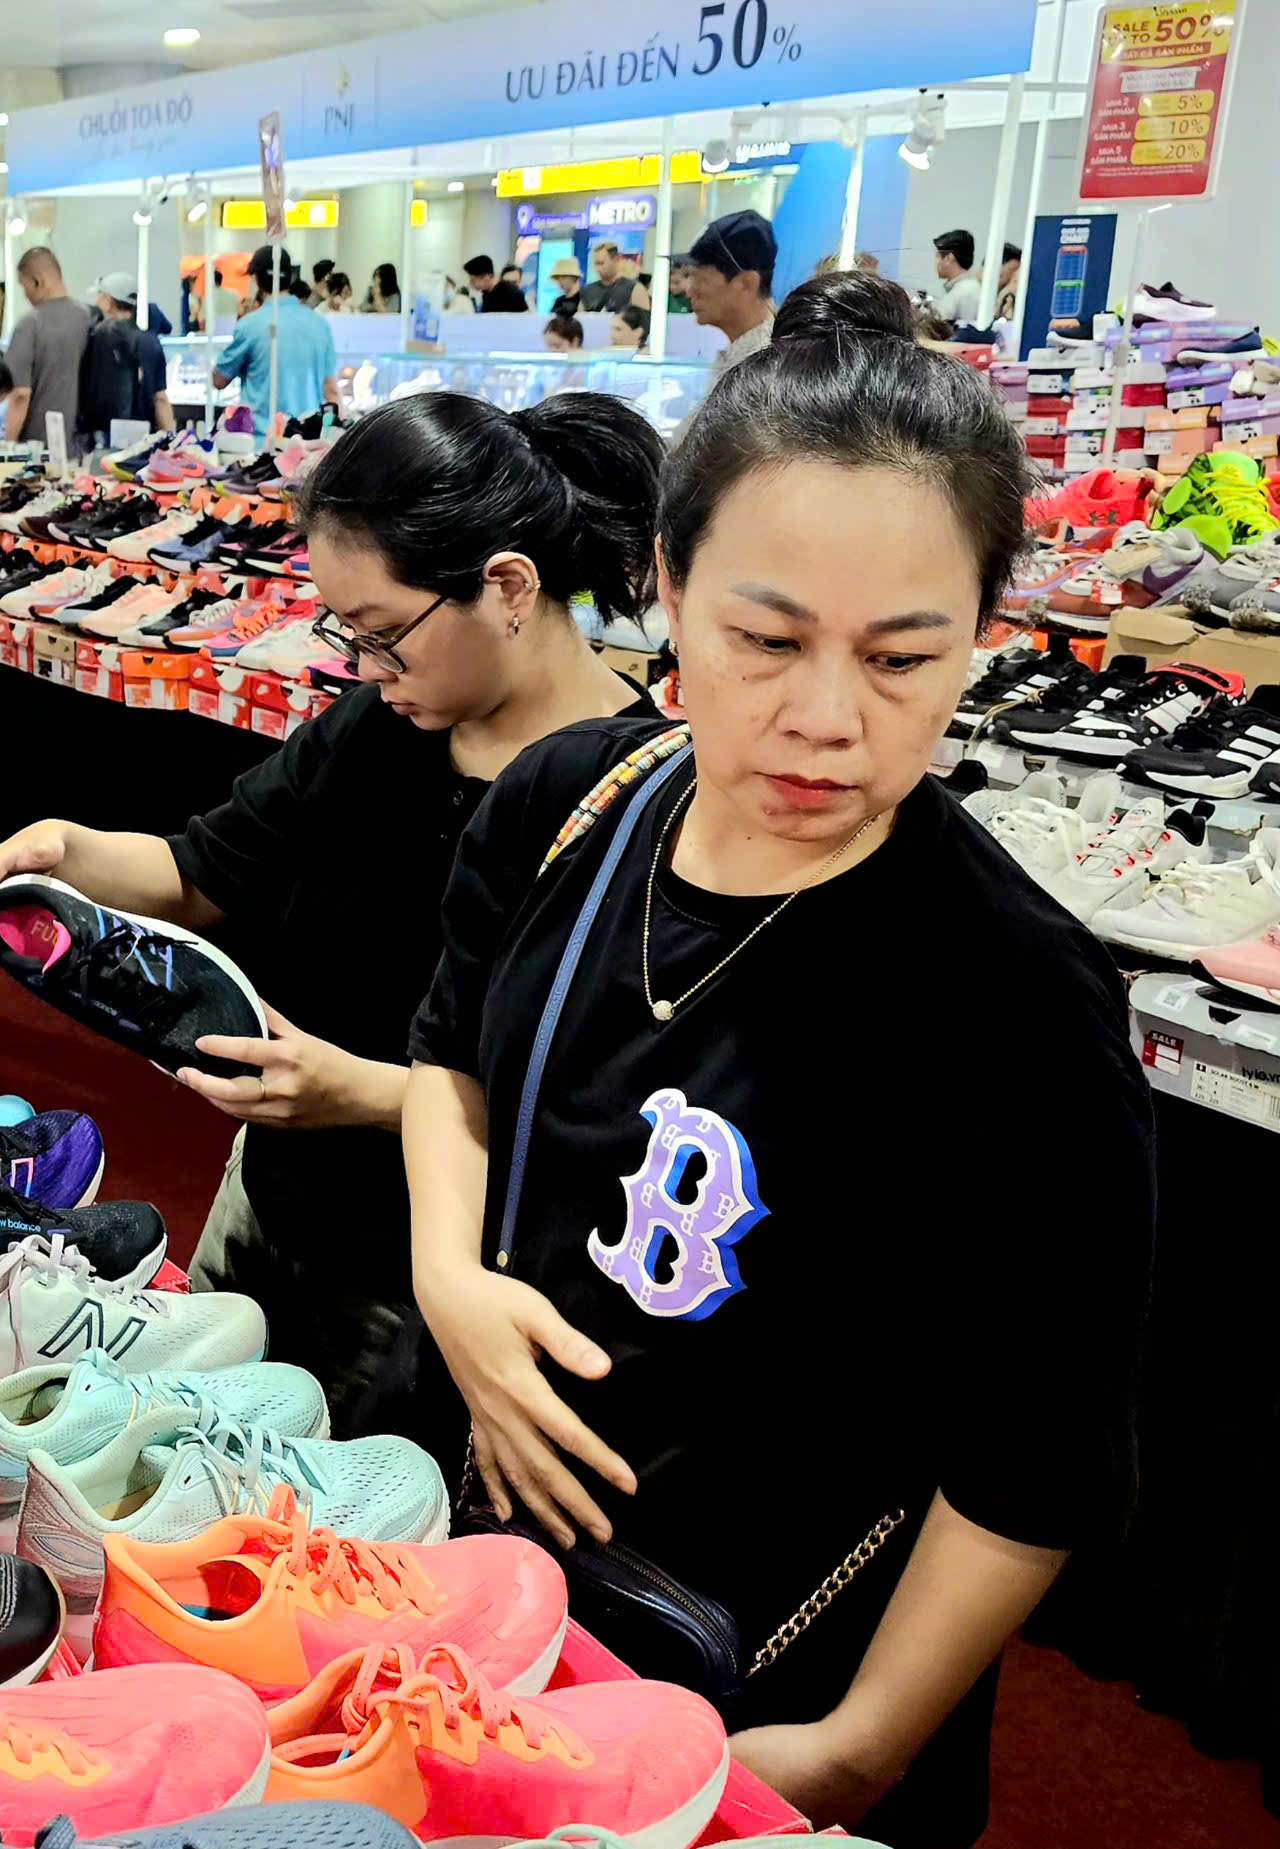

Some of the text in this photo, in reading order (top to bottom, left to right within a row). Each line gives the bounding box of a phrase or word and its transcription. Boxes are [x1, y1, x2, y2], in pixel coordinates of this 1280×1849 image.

[1153, 13, 1226, 43] 50%
[1131, 33, 1151, 44] TO
[556, 51, 605, 95] ĐÃI
[616, 32, 680, 86] ĐẾN
[692, 0, 802, 76] 50%
[1177, 94, 1203, 110] 5%
[1170, 118, 1204, 135] 10%
[1164, 143, 1200, 160] 20%
[589, 200, 651, 226] METRO
[1151, 1032, 1177, 1046] SALE
[587, 1088, 771, 1321] B
[8, 1218, 42, 1233] balance
